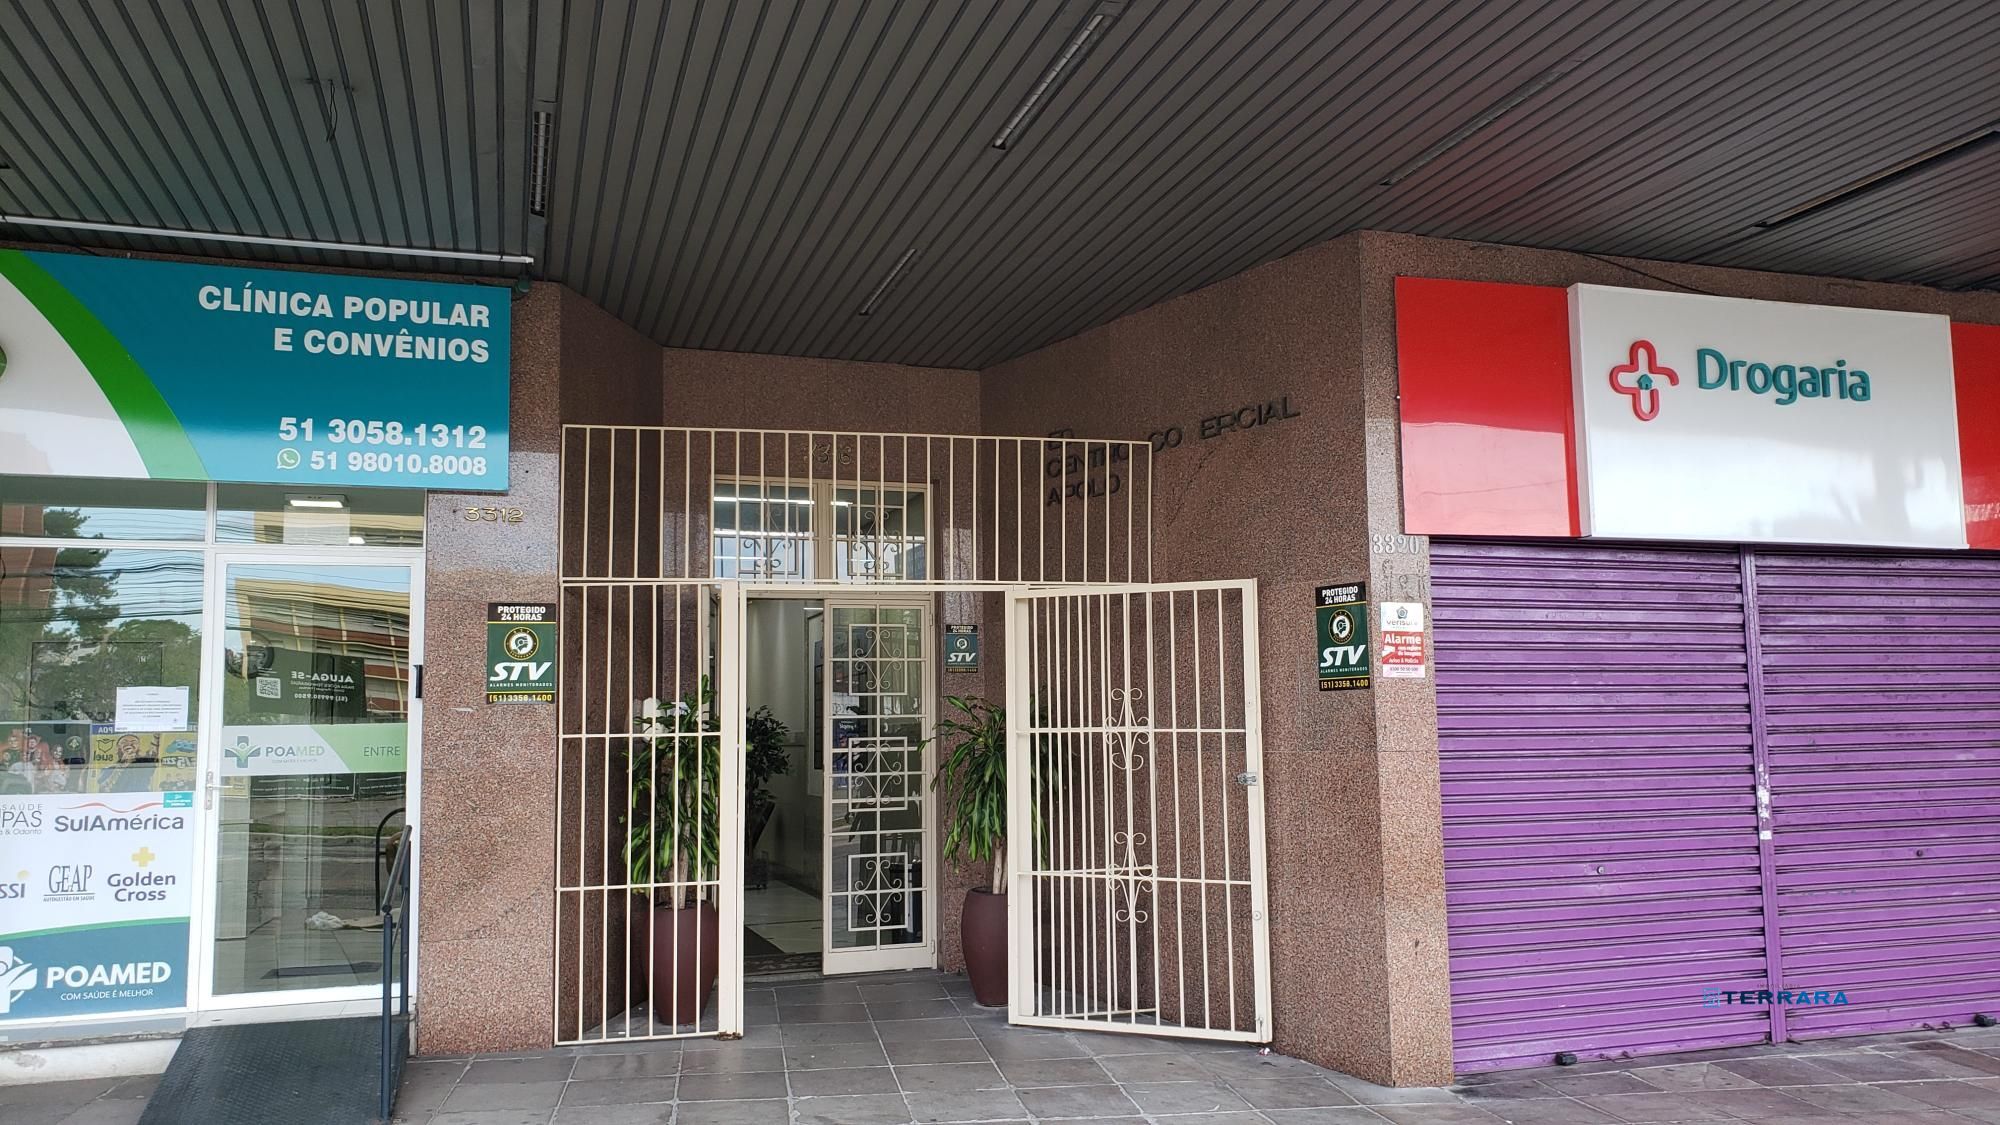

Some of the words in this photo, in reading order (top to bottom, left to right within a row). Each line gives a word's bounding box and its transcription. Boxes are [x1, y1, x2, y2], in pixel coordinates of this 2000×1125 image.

[198, 281, 334, 318] CLÍNICA
[344, 295, 490, 328] POPULAR
[274, 327, 293, 352] E
[303, 328, 490, 363] CONVÊNIOS
[1697, 348, 1871, 406] Drogaria
[278, 416, 314, 442] 51
[327, 418, 487, 449] 3058.1312
[310, 450, 338, 471] 51
[348, 452, 487, 476] 98010.8008
[463, 506, 525, 523] 3312
[1372, 533, 1420, 555] 3320
[1322, 585, 1358, 597] PROTEGIDO
[1325, 597, 1333, 605] 24
[1333, 594, 1356, 604] HORAS
[497, 606, 546, 614] PROTEGIDO
[501, 613, 512, 621] 24
[513, 613, 543, 621] HORAS
[1384, 633, 1422, 645] Alarme
[947, 652, 977, 662] STV
[1319, 644, 1366, 668] STV
[489, 661, 553, 681] STV
[265, 745, 325, 757] POAMED
[363, 746, 401, 757] ENTRE
[0, 810, 42, 828] PAS
[54, 814, 184, 832] SulAmérica
[12, 828, 42, 836] Odonto
[48, 864, 93, 893] GEAP
[107, 872, 176, 888] Golden
[114, 888, 166, 902] Cross
[46, 961, 172, 988] POAMED
[60, 992, 81, 1001] COM
[83, 990, 111, 1000] SAÚDE
[112, 989, 117, 998] É
[119, 988, 154, 997] MELHOR
